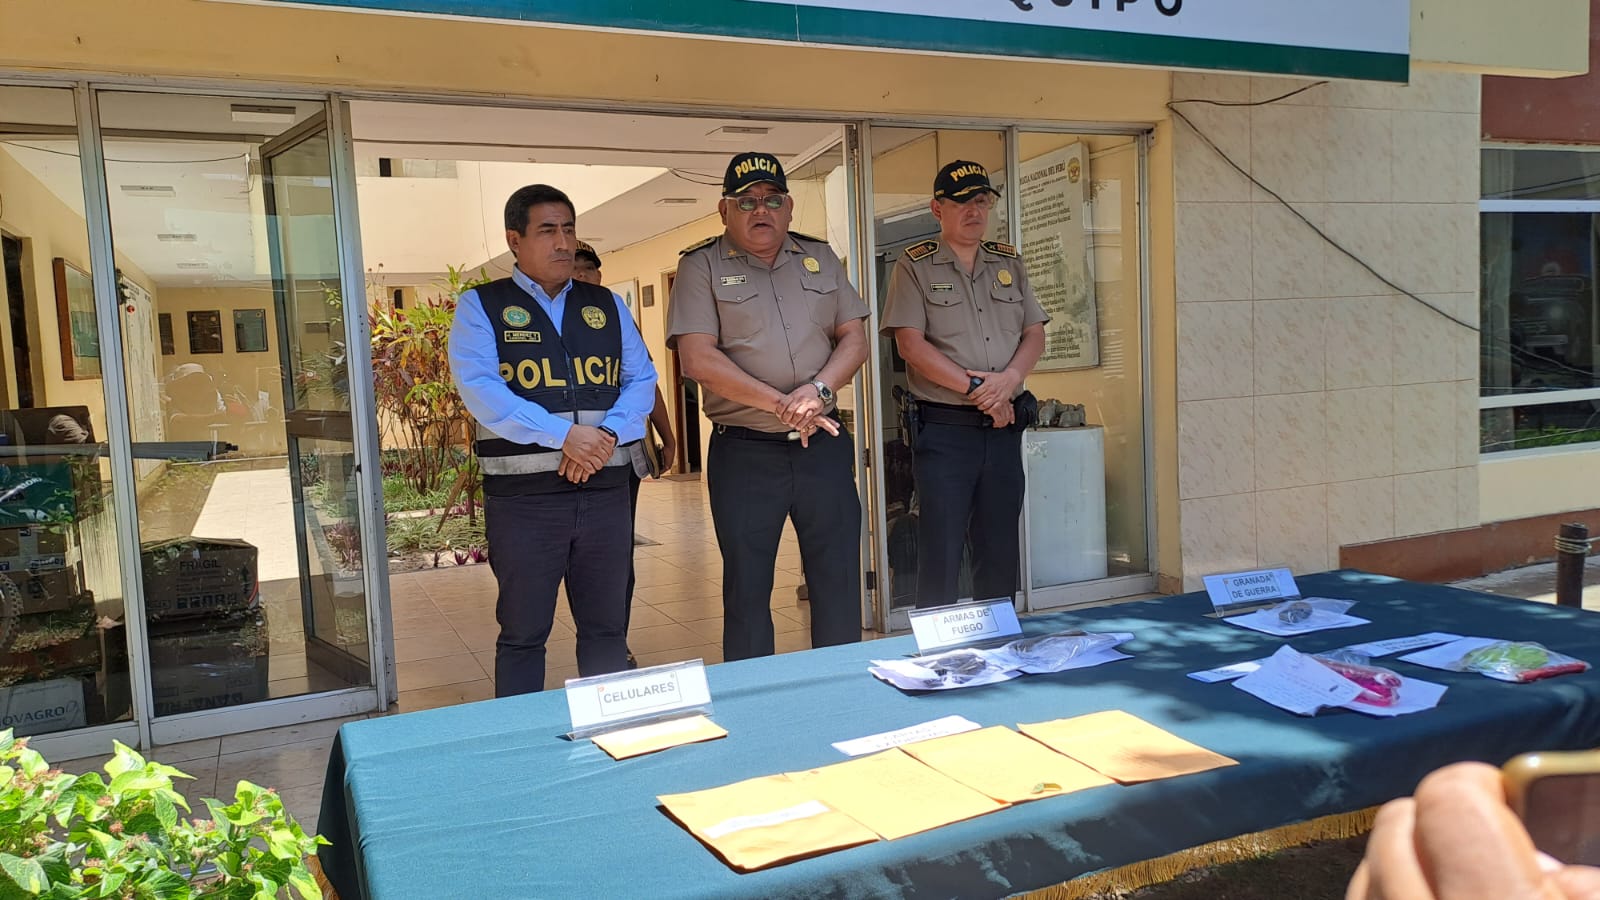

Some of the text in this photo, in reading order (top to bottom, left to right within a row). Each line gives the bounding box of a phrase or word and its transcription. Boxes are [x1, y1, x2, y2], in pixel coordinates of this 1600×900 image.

[735, 157, 777, 178] POLICIA
[950, 165, 987, 181] POLICIA
[1233, 575, 1270, 587] GRANADA
[1231, 585, 1277, 598] DE GUERRA
[943, 608, 989, 625] ARMAS DE
[951, 622, 983, 635] FUEGO
[603, 681, 675, 704] CELULARES
[0, 706, 65, 727] OVAGRO
